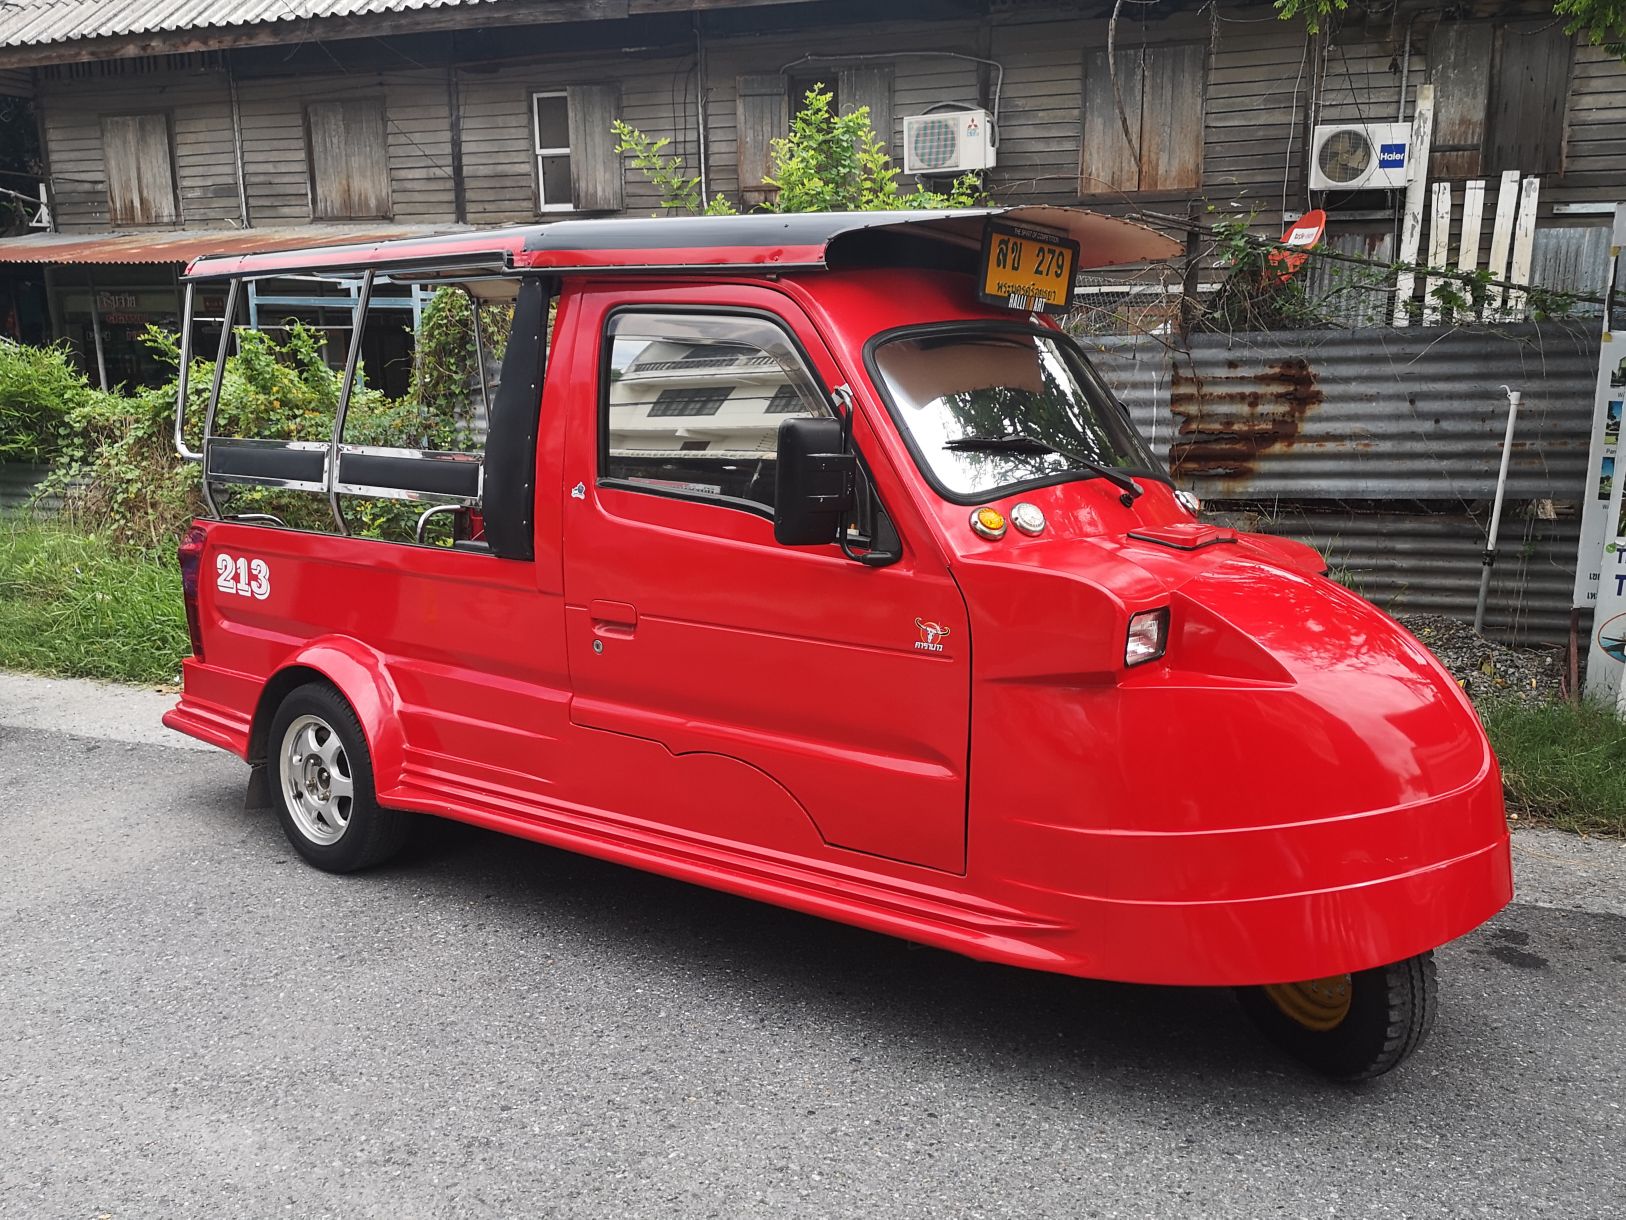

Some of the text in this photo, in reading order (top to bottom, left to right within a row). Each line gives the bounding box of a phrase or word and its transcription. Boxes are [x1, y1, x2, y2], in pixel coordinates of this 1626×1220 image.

[1380, 152, 1405, 161] Haier
[1035, 247, 1064, 278] 279
[217, 554, 270, 600] 213
